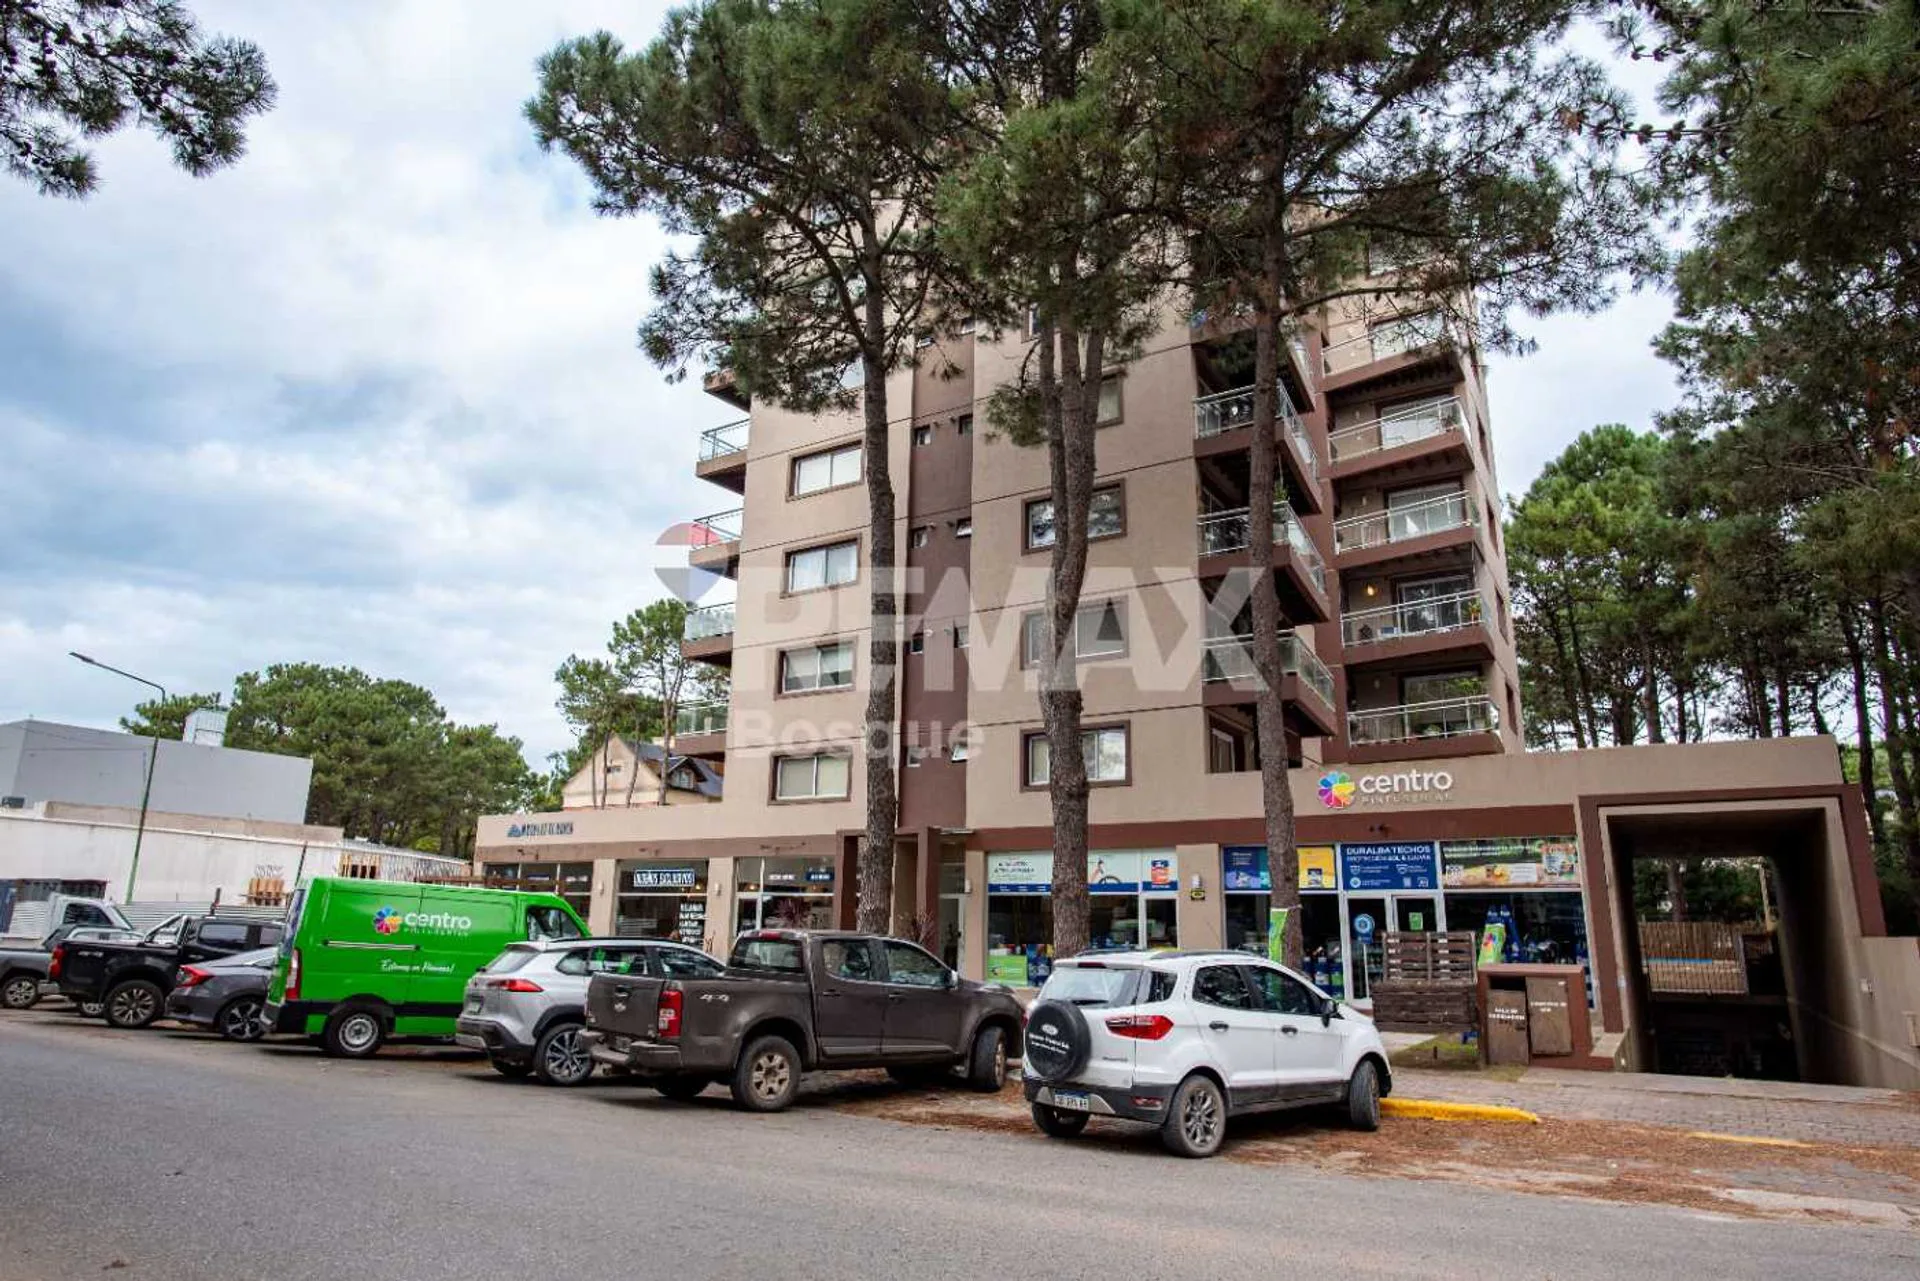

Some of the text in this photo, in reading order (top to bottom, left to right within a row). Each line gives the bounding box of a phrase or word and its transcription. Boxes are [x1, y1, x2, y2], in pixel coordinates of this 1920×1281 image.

[1360, 769, 1453, 793] centro
[1391, 845, 1431, 854] TECHOS
[404, 911, 472, 930] centro
